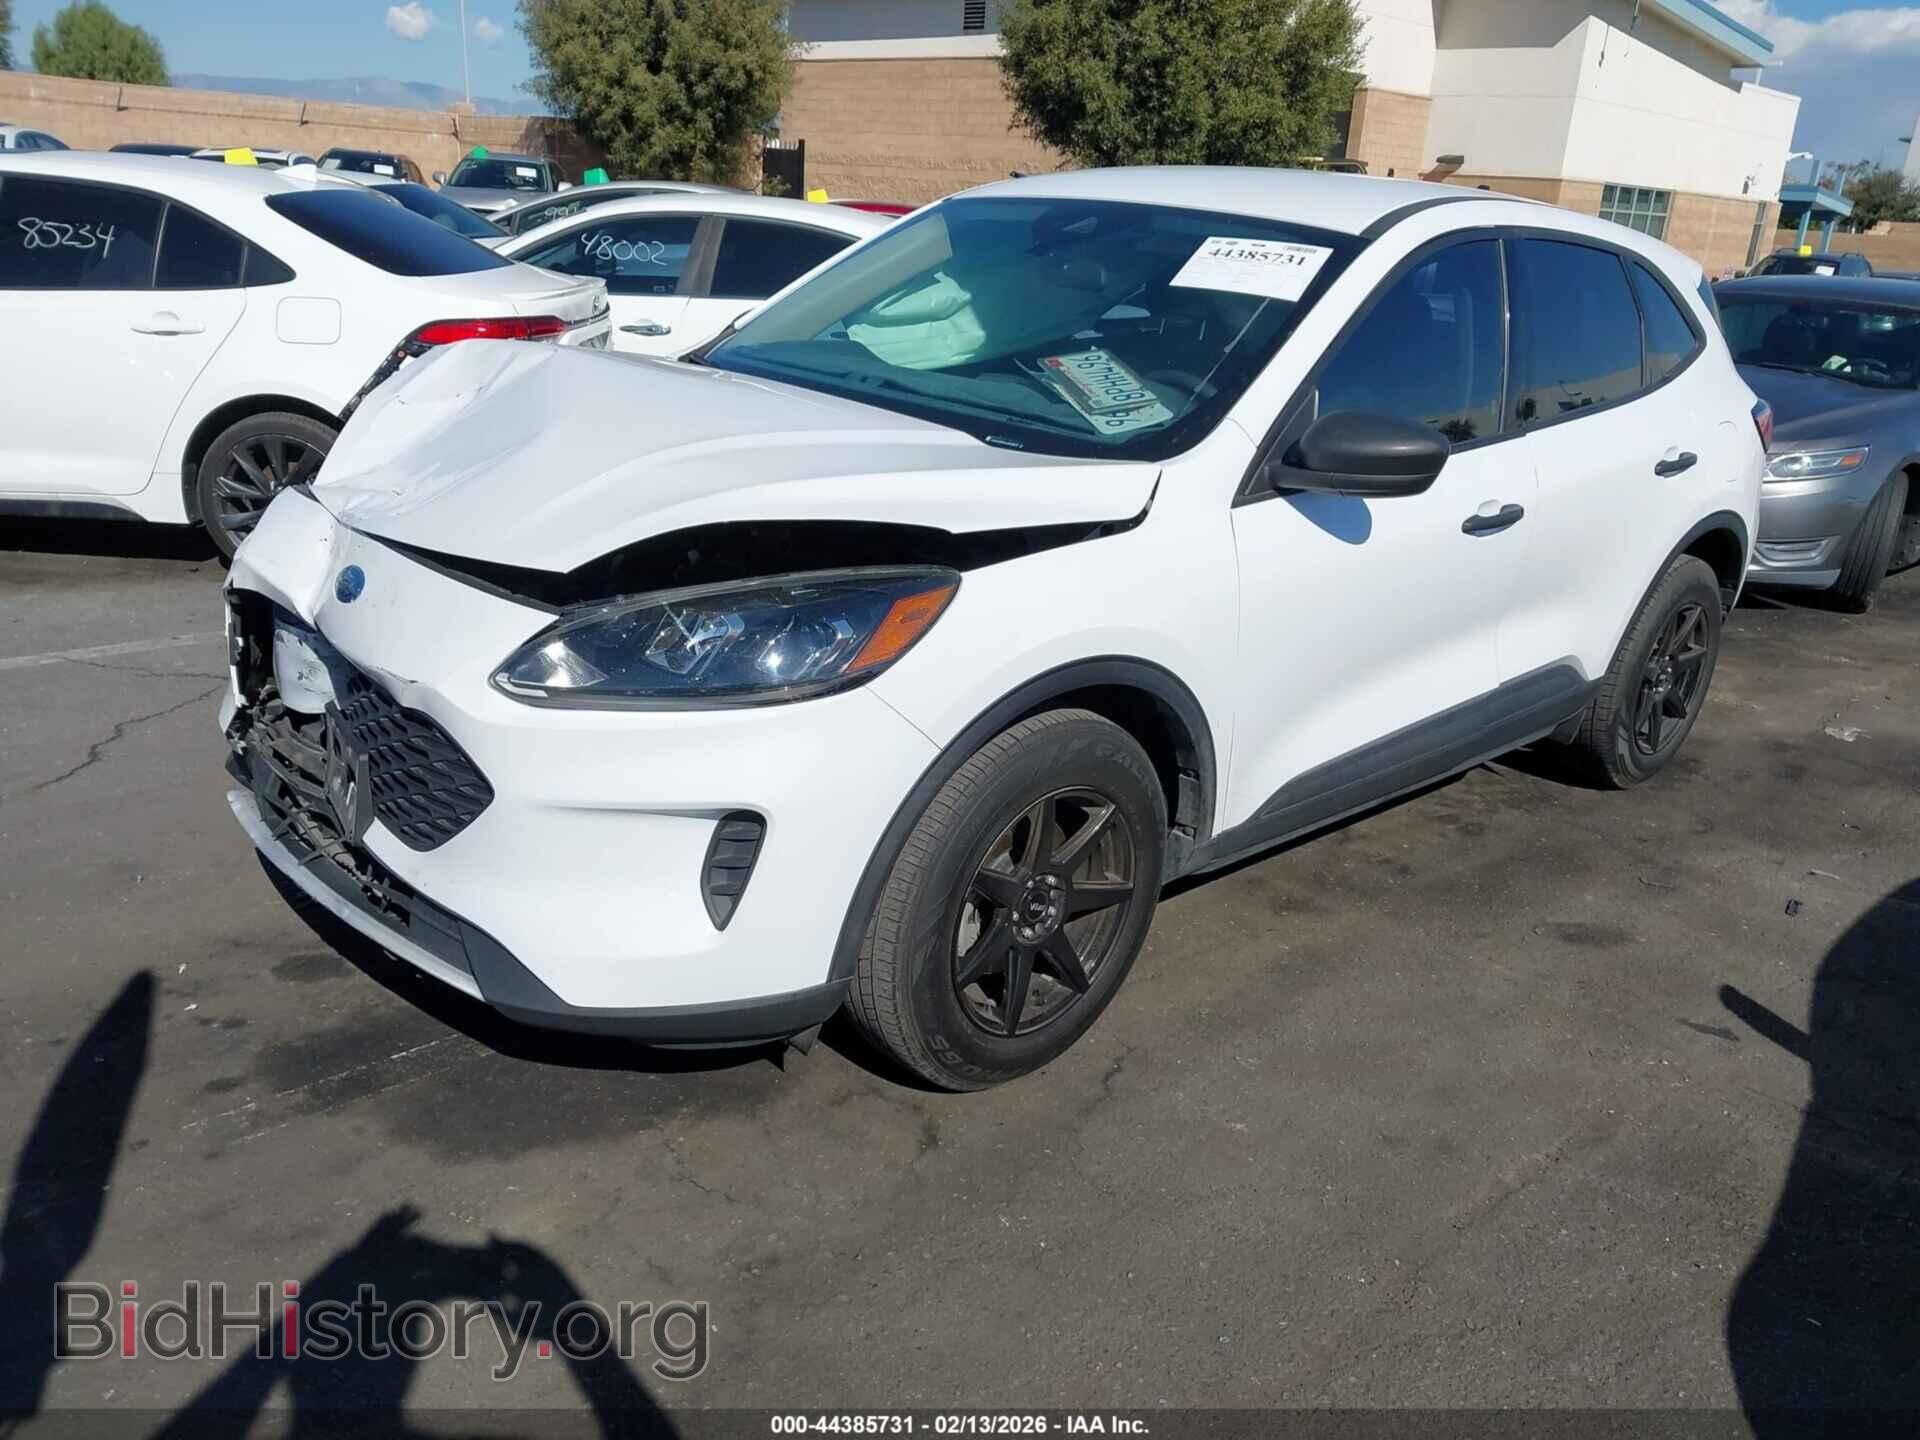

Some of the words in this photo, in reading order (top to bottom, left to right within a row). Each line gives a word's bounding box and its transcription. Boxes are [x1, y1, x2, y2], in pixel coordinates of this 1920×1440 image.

[17, 217, 116, 259] 85234
[581, 232, 668, 266] 48002
[1208, 247, 1306, 266] 44385731
